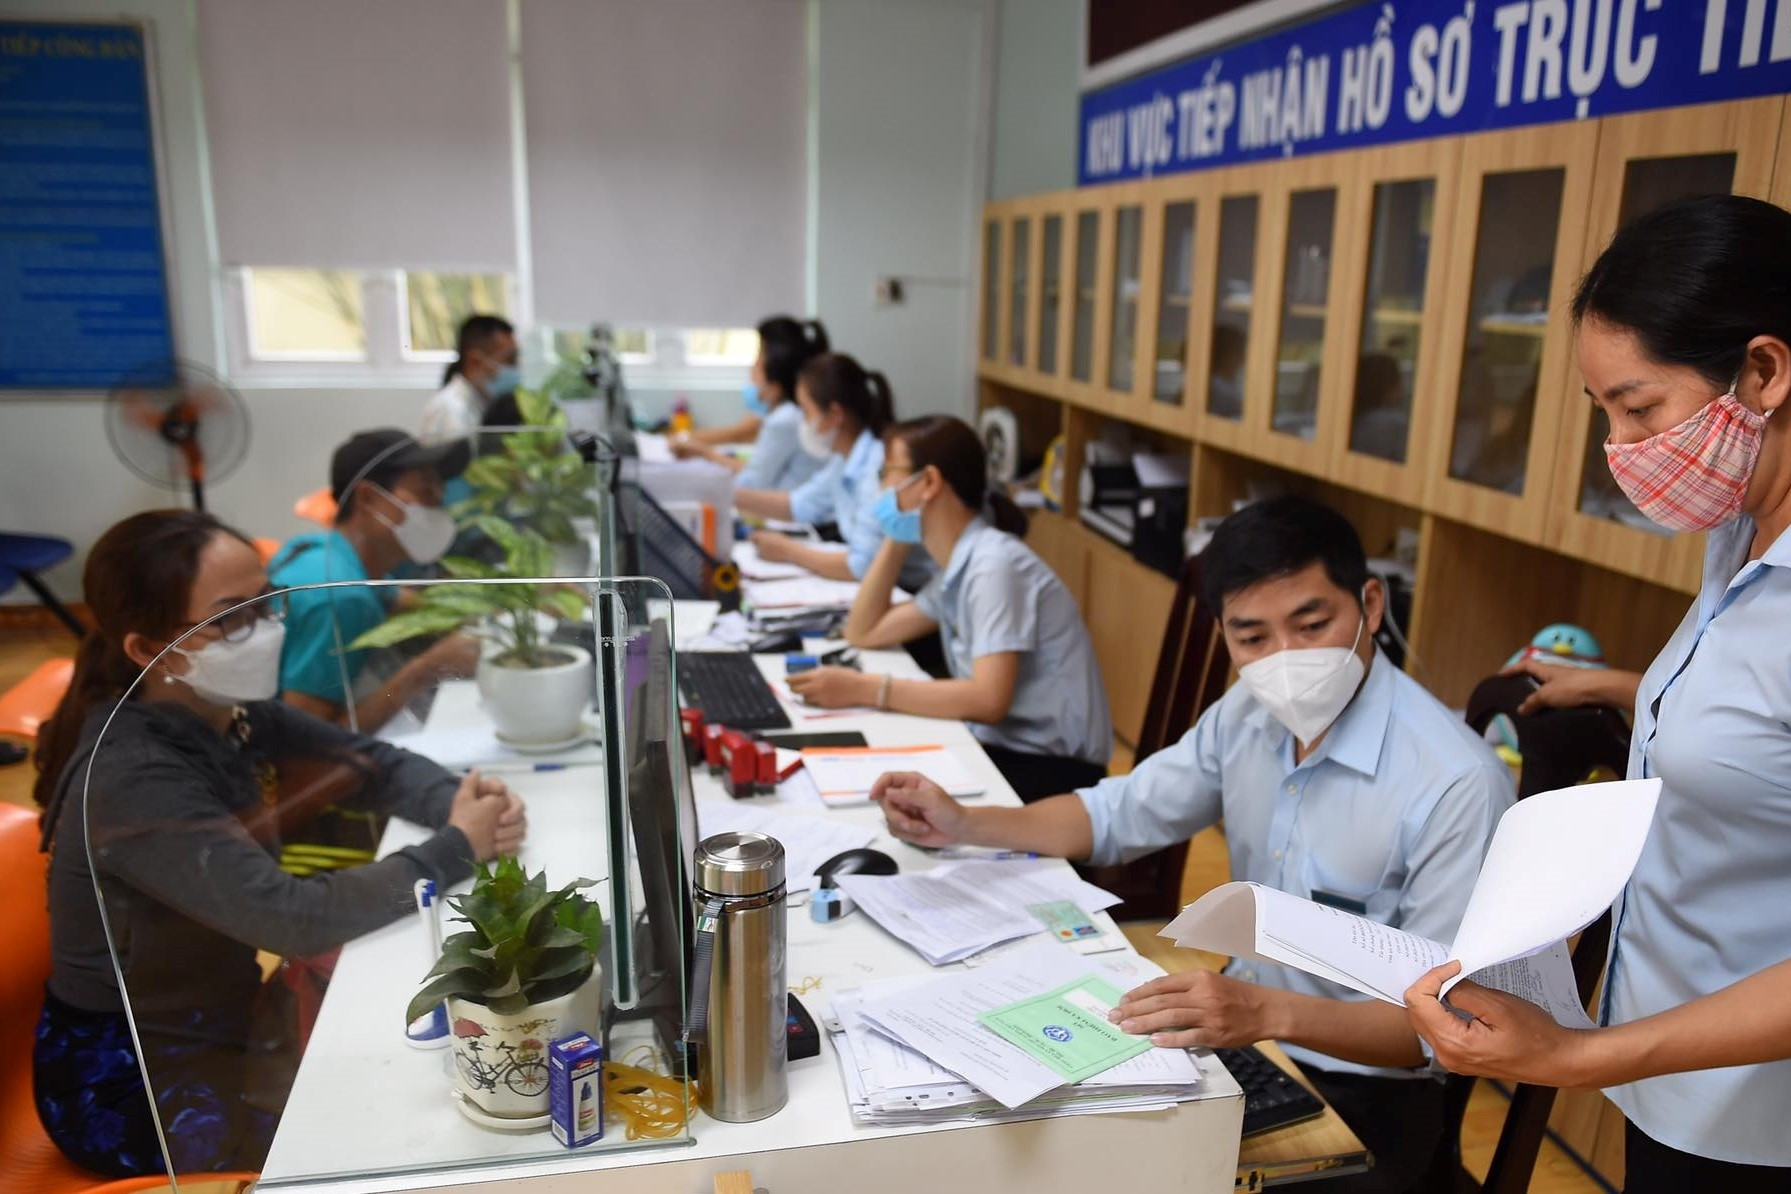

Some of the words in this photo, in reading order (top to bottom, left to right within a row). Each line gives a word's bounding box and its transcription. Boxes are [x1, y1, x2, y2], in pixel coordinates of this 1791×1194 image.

[1087, 110, 1125, 176] KHU
[1178, 57, 1236, 161] TIẾP
[1239, 45, 1330, 157] NHẬN
[1337, 2, 1396, 134] HỒ
[1405, 0, 1476, 123] SƠ
